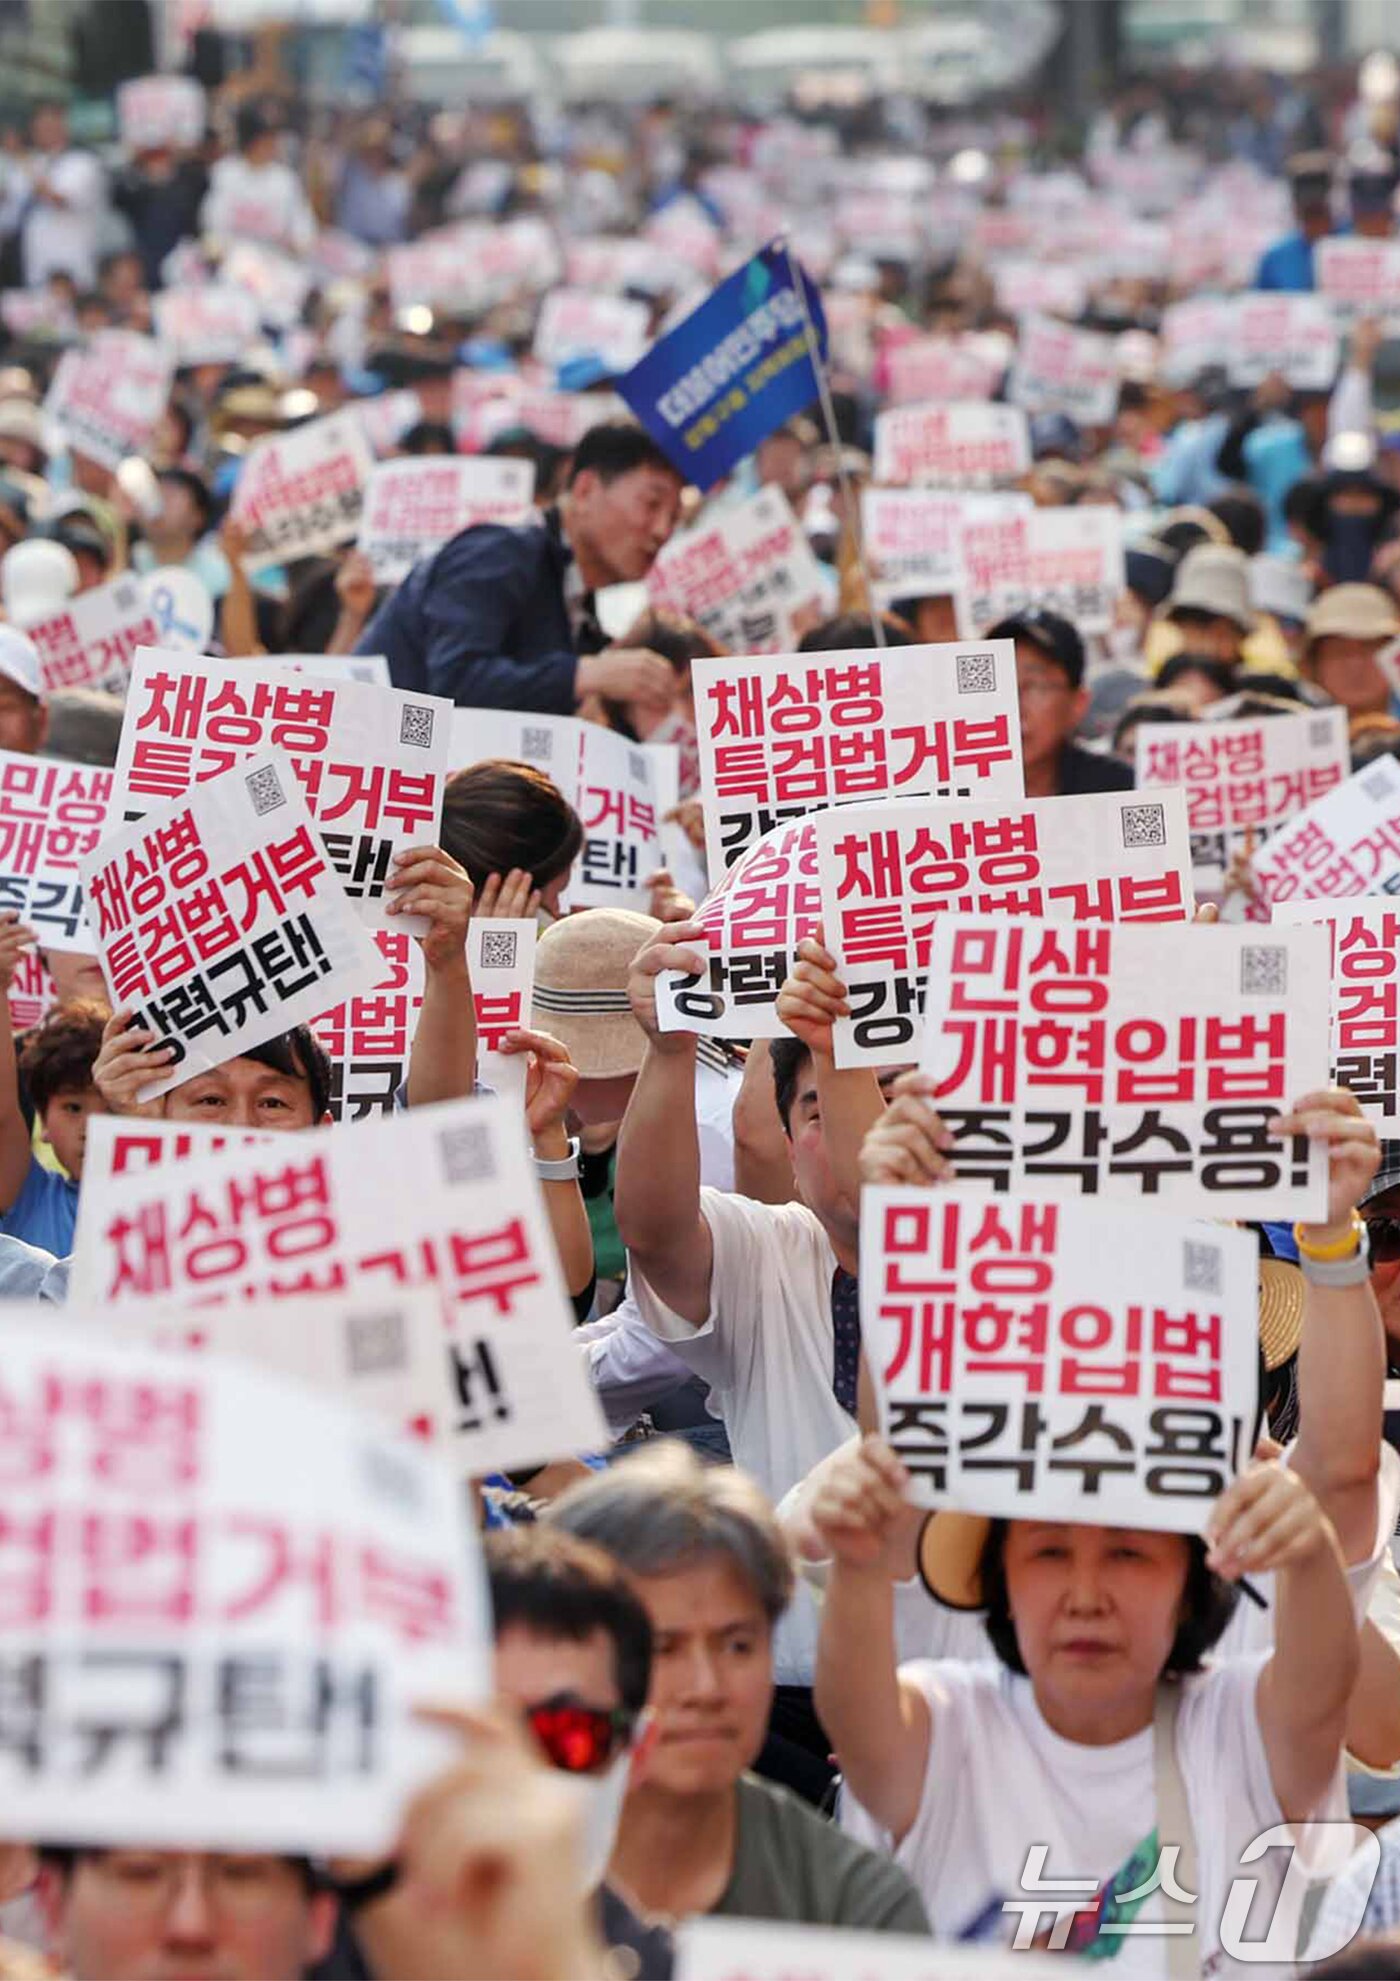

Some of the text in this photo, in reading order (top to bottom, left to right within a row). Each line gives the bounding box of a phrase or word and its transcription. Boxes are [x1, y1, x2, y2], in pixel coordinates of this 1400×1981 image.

[136, 671, 336, 753] 채상병
[707, 662, 884, 739] 채상병
[0, 763, 114, 825] 민생
[128, 740, 436, 834] 특거부
[713, 714, 1013, 803] 특검법거부
[1145, 730, 1264, 783] 채상병
[90, 808, 210, 941] 채상병
[833, 813, 1042, 901] 채상병
[106, 825, 326, 1002] 특검법거부
[669, 951, 800, 1021] 강력
[949, 925, 1111, 1014] 민생
[933, 1013, 1286, 1104] 개혁입법
[934, 1105, 1309, 1195] 즉각수용!
[105, 1155, 337, 1300] 채상병
[882, 1202, 1059, 1295] 민생
[878, 1302, 1222, 1402] 개혁입법
[887, 1401, 1243, 1498] 즉각수용!
